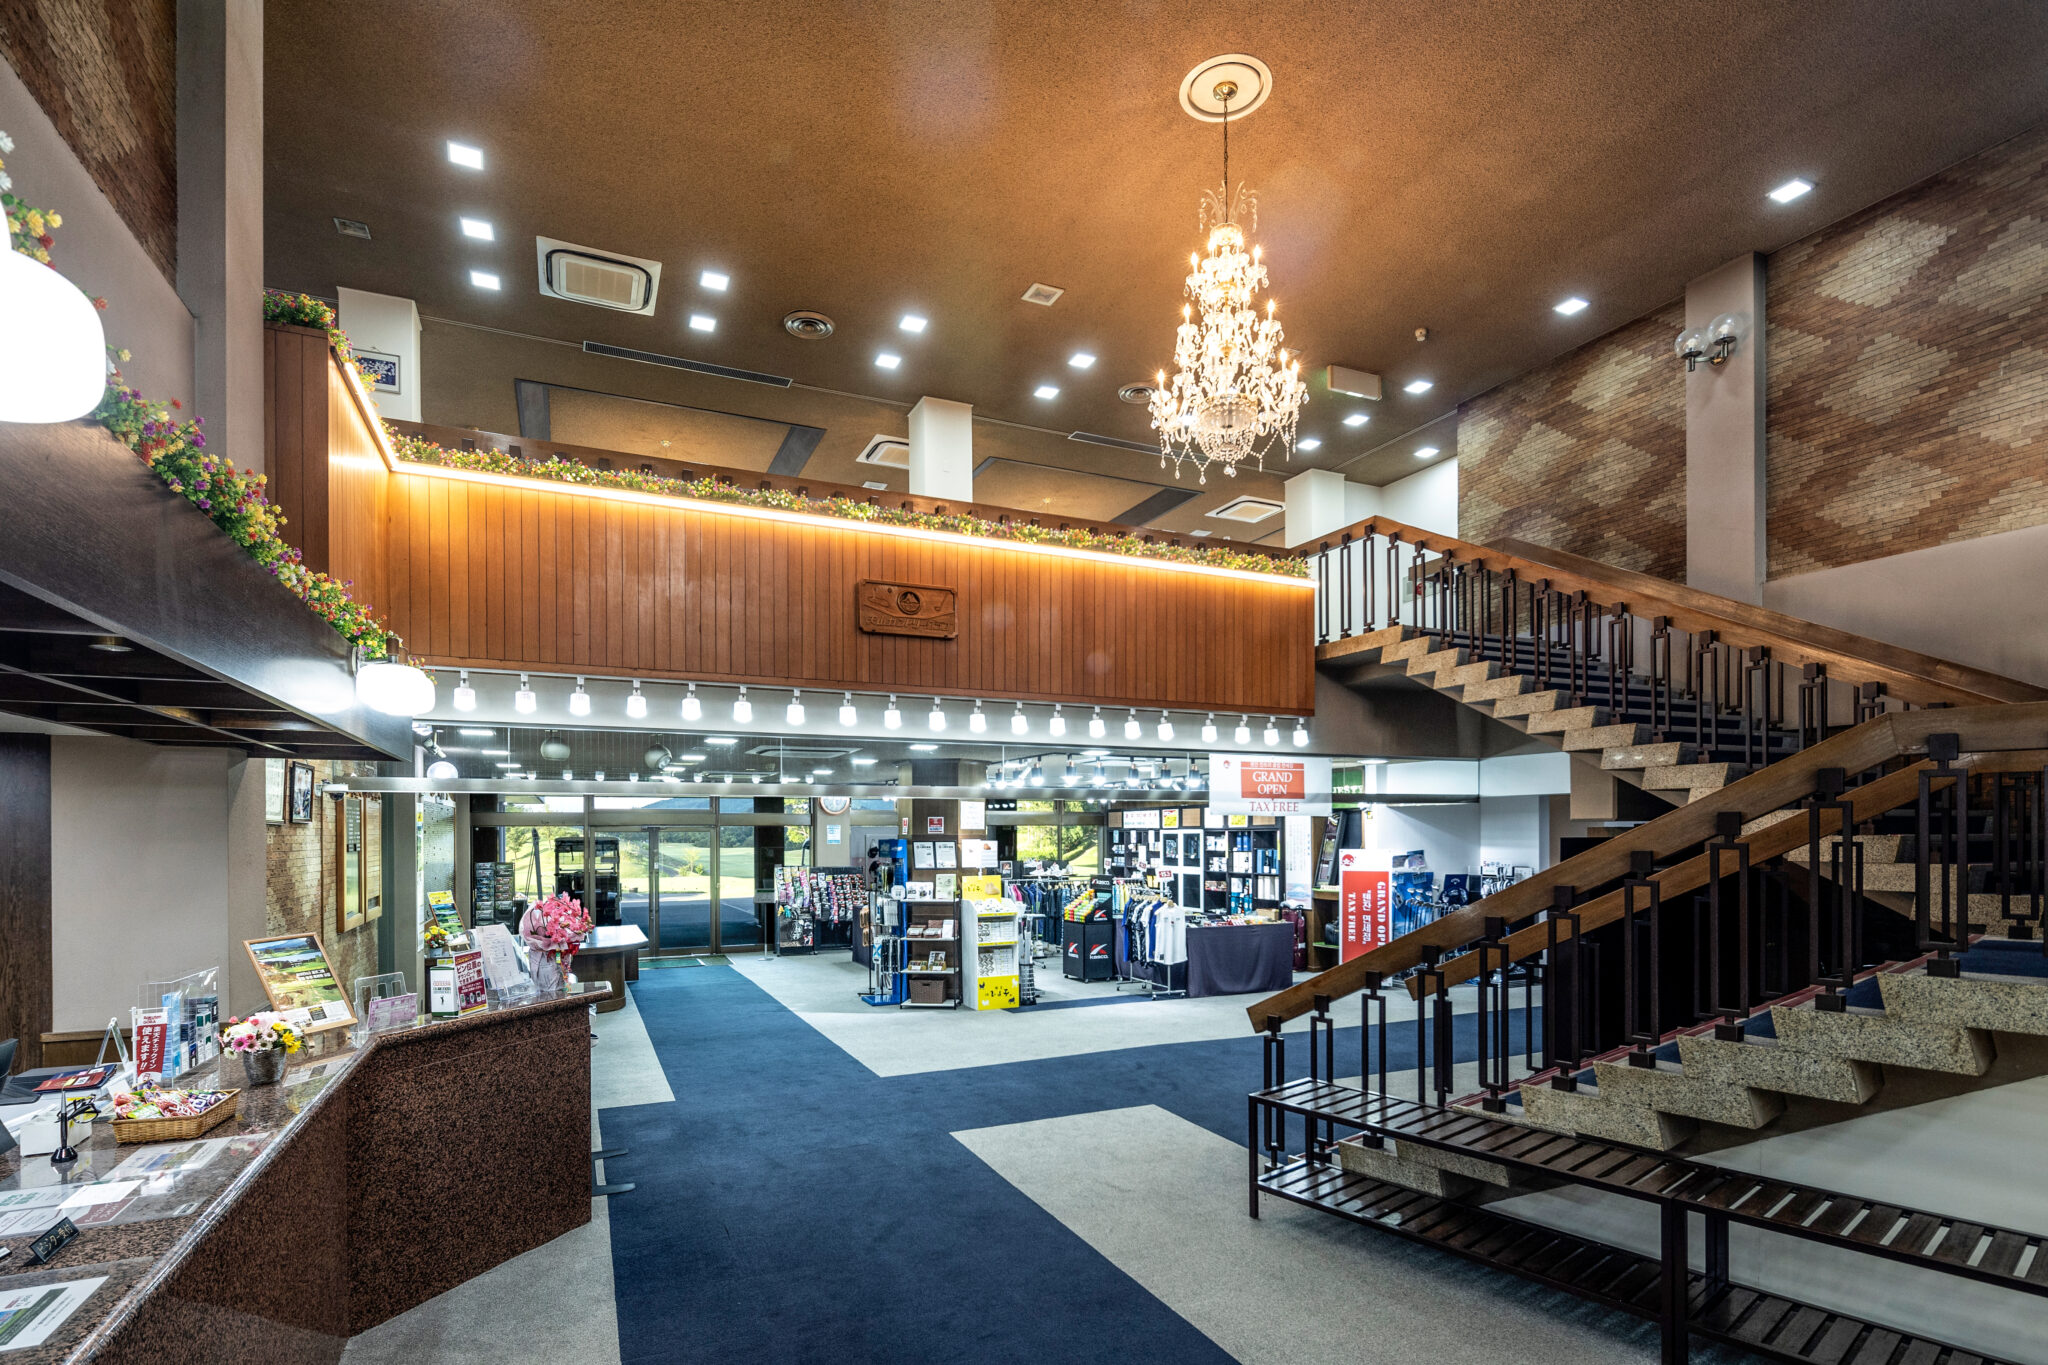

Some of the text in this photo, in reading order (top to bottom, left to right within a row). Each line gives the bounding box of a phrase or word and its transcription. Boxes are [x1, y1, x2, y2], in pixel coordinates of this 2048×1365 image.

[1252, 771, 1293, 783] GRAND
[1257, 783, 1288, 795] OPEN
[1249, 801, 1299, 812] TAX FREE
[1347, 892, 1357, 942] TAX FREE
[1376, 881, 1387, 923] GRAND
[148, 1026, 162, 1070] 楽天チェックイン
[36, 1223, 74, 1255] ビジター受付
